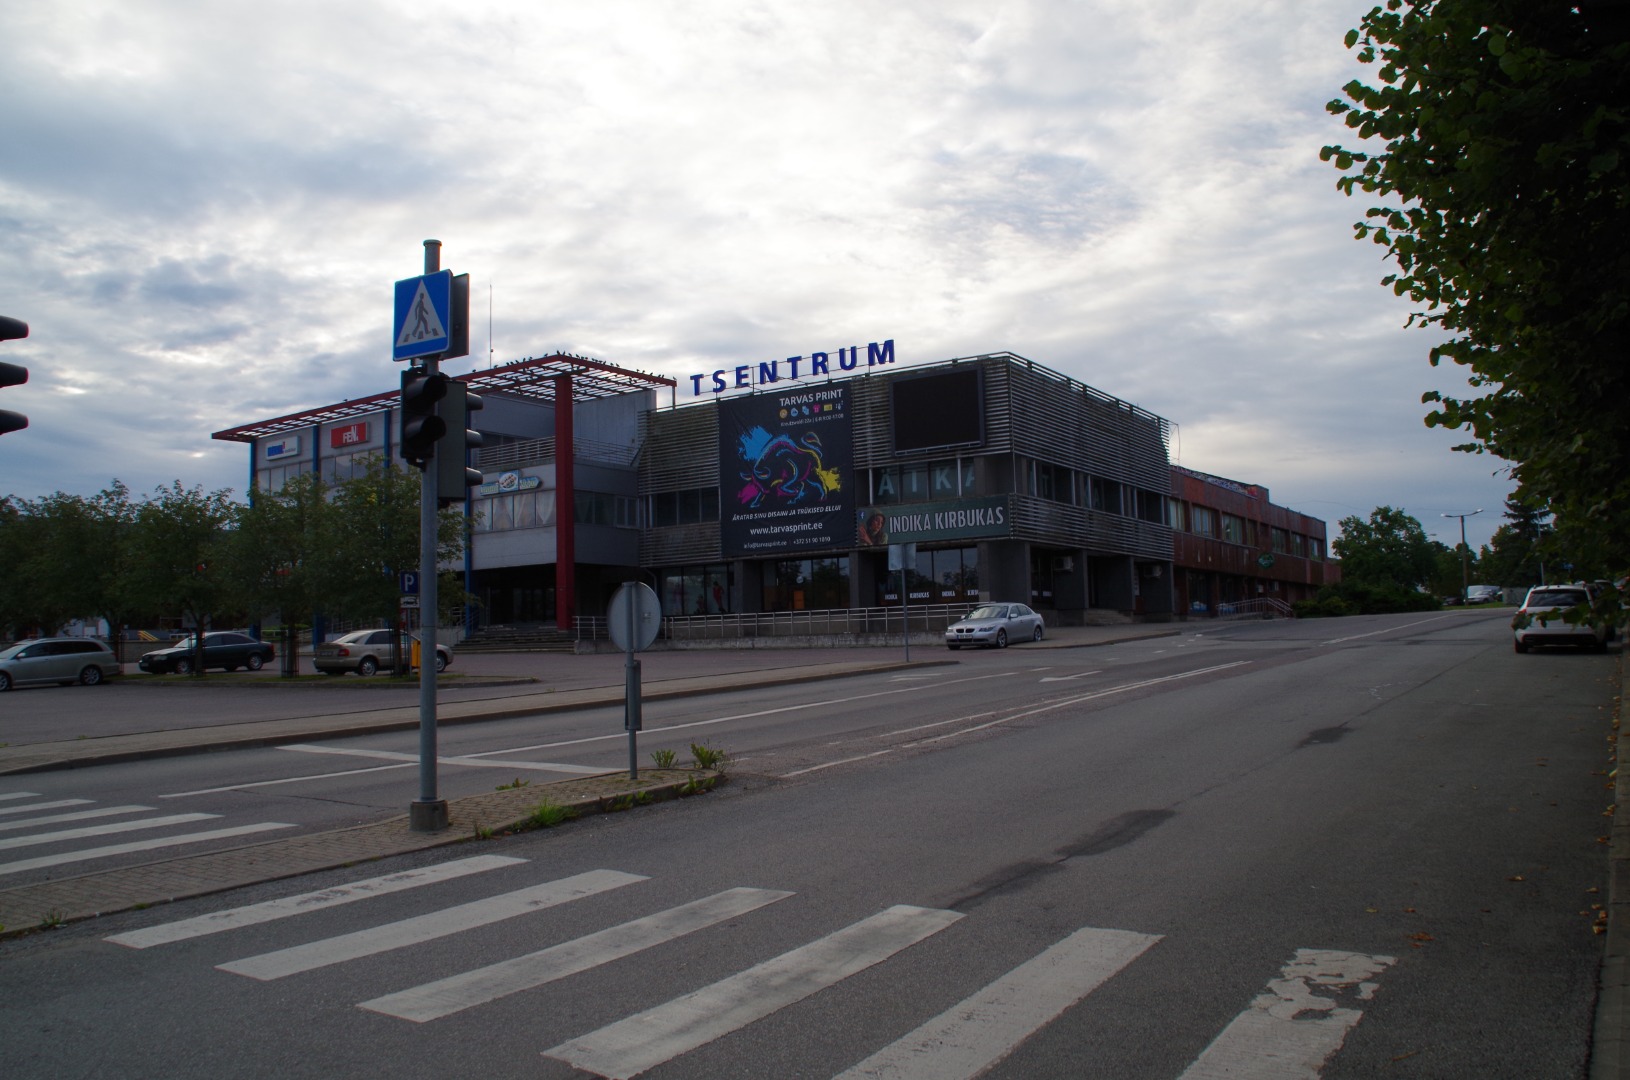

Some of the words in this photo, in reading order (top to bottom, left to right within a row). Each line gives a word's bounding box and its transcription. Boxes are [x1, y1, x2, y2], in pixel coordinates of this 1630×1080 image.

[690, 339, 895, 396] TSENTRUM
[779, 393, 814, 407] TARVAS
[815, 388, 843, 401] PRINT
[797, 506, 824, 515] TRÜKISED
[889, 513, 931, 533] INDIKA
[935, 506, 1004, 530] KIRBUKAS
[750, 522, 823, 535] www.tarvasprint.ee
[404, 573, 415, 592] P
